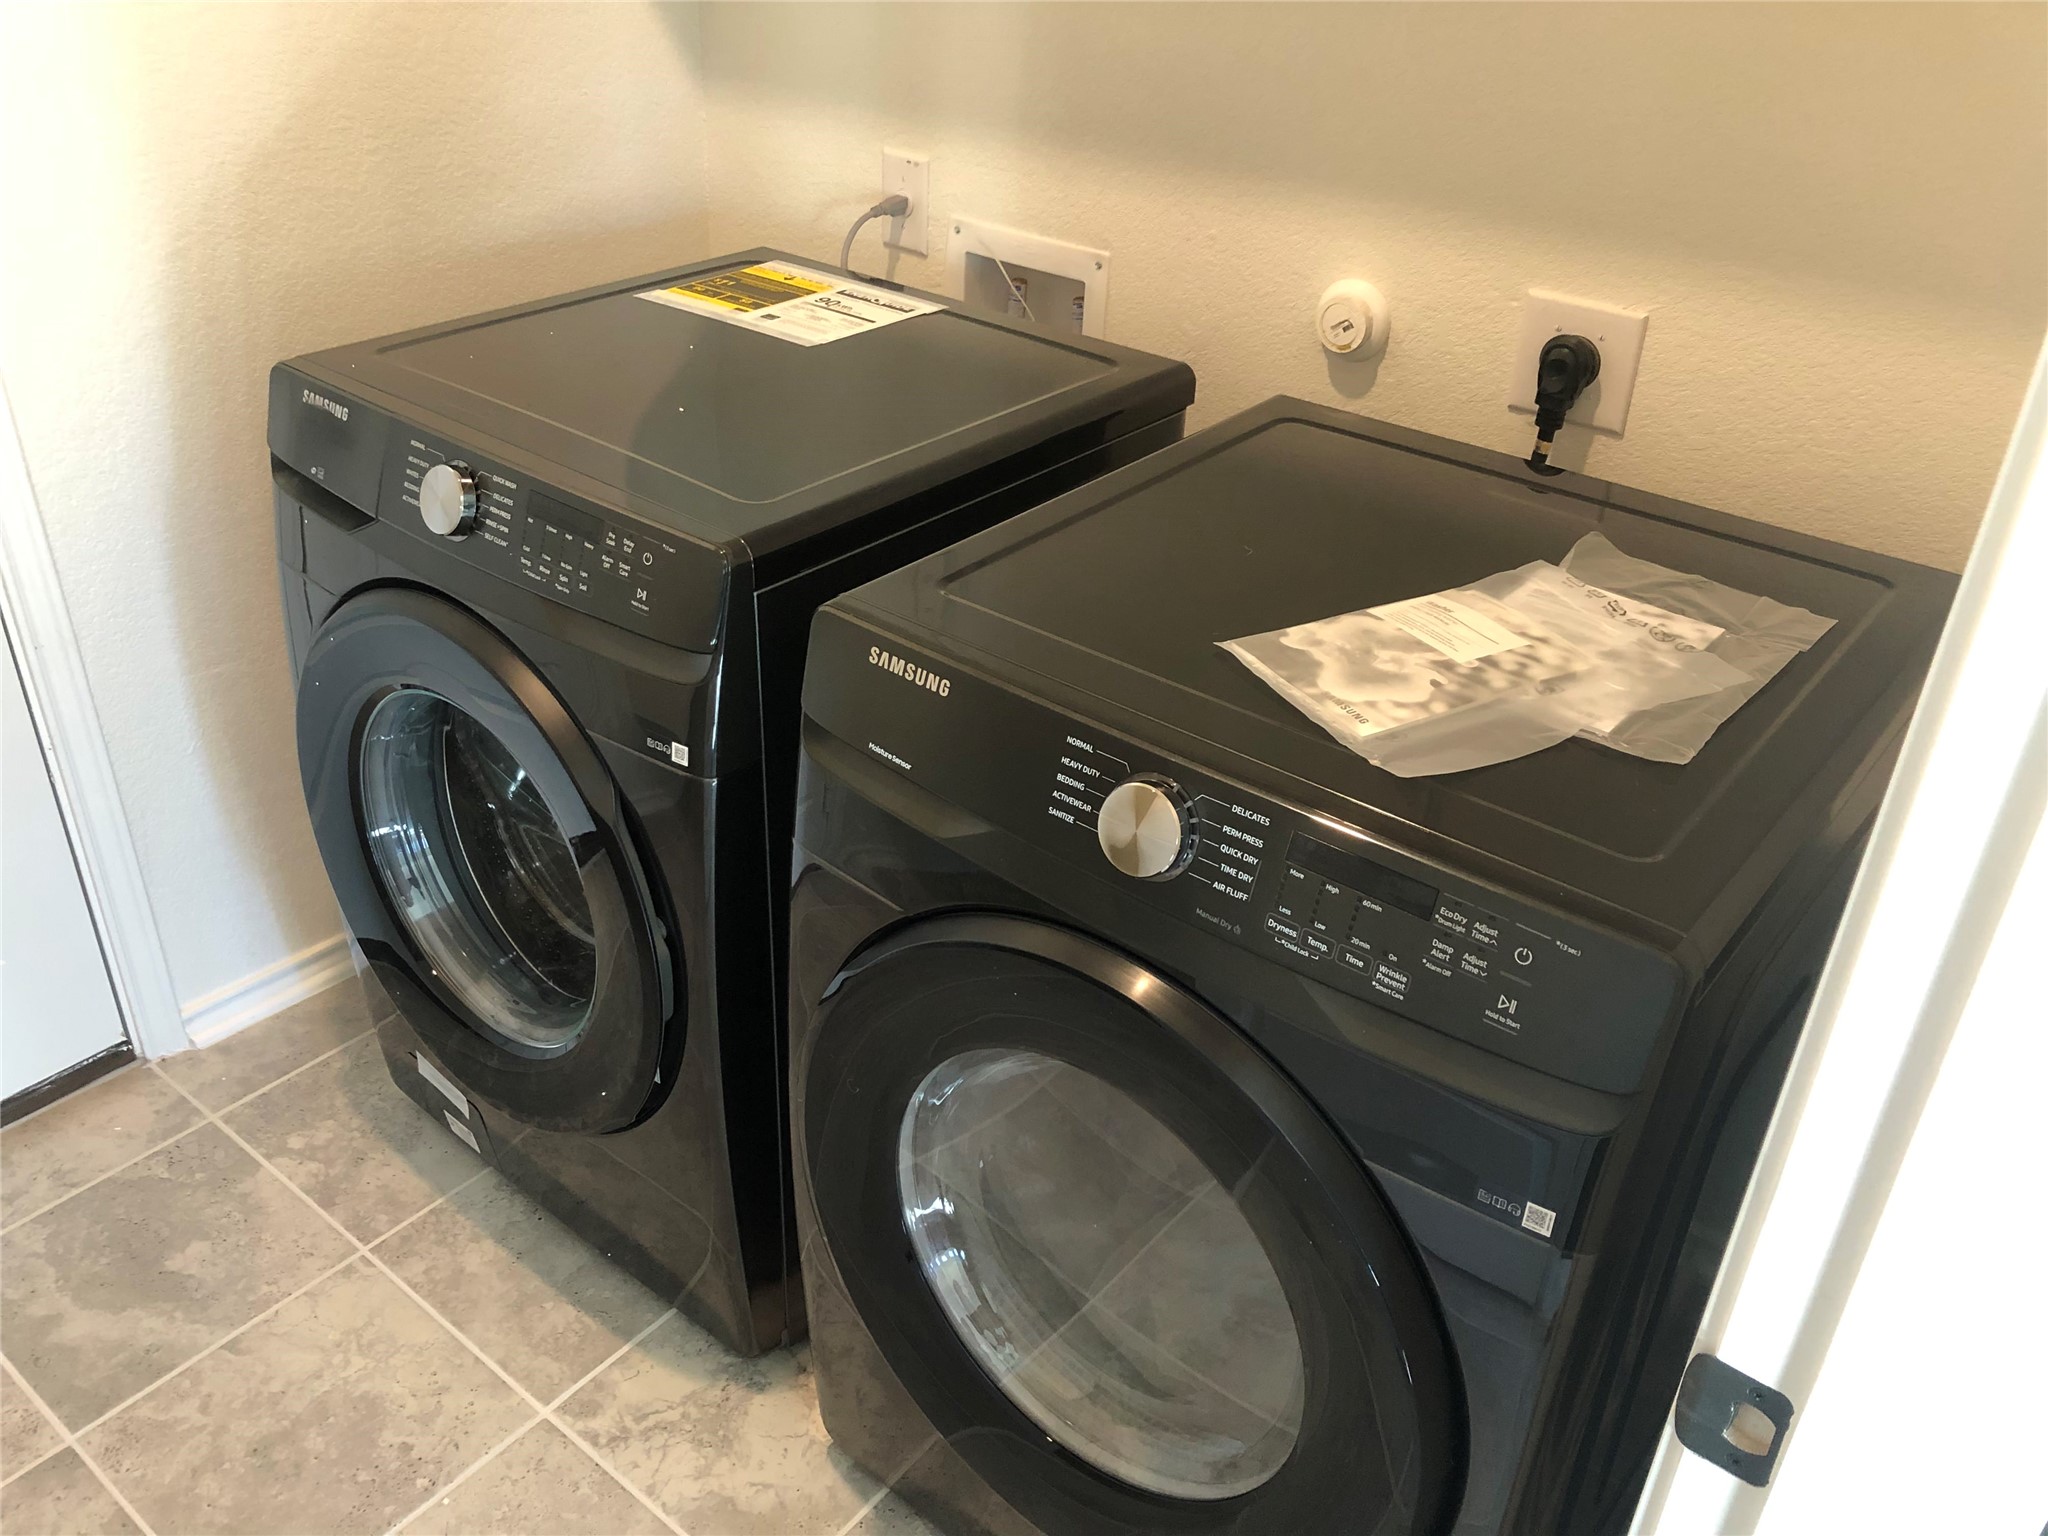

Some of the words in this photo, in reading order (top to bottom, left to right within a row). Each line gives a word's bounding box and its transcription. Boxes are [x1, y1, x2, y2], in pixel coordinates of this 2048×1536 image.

[814, 297, 842, 308] 90
[302, 389, 349, 421] SAMSUNG
[420, 460, 430, 468] DUTY
[505, 480, 517, 490] WASH
[493, 492, 514, 506] DELICATES
[484, 532, 494, 540] SELF
[606, 538, 616, 546] Soak
[623, 538, 635, 548] Delay
[624, 545, 632, 553] End
[602, 554, 614, 564] Alarm
[539, 565, 550, 574] Rinse
[619, 562, 631, 571] Smart
[619, 569, 628, 577] Care
[559, 574, 568, 582] Spin
[579, 583, 588, 591] Soil
[869, 646, 951, 697] SAMSUNG
[1321, 691, 1369, 724] MSUNG
[1066, 736, 1094, 753] NORMAL
[869, 742, 892, 759] Moisture
[892, 755, 912, 770] Sensor
[1061, 756, 1083, 770] HEAVY
[1083, 765, 1100, 778] DUTY
[1056, 773, 1085, 790] BEDDING
[1052, 790, 1092, 813] ACTIVEWEAR
[1048, 806, 1075, 824] SANITIZE
[1232, 804, 1270, 827] DELICATES
[1222, 825, 1242, 839] PERM
[1242, 833, 1264, 848] PRESS
[1220, 844, 1242, 860] QUICK
[1243, 853, 1259, 866] DRY
[1220, 863, 1237, 878] TIME
[1238, 872, 1254, 884] DRY
[1289, 868, 1305, 879] More
[1212, 881, 1225, 892] AIR
[1226, 886, 1249, 902] FLUFF
[1325, 884, 1339, 894] High
[1279, 905, 1291, 915] Less
[1362, 900, 1371, 908] 60
[1371, 903, 1382, 912] min
[1196, 907, 1220, 924] Manual
[1220, 918, 1232, 931] Dry
[1440, 906, 1453, 918] Eco
[1453, 912, 1468, 924] Dry
[1268, 918, 1297, 938] Dryness
[1314, 921, 1326, 931] Low
[1452, 923, 1466, 933] Light
[1474, 922, 1499, 937] Adjust
[1307, 935, 1328, 952] Temp.
[1351, 936, 1360, 945] 20
[1359, 940, 1370, 950] min
[1471, 930, 1490, 943] Time
[1297, 947, 1309, 957] Lock
[1432, 938, 1454, 954] Damp
[1345, 953, 1364, 968] Time
[1388, 953, 1398, 962] On
[1430, 948, 1450, 961] Alert
[1463, 952, 1488, 968] Adjust
[1379, 964, 1408, 983] Wrinkle
[1442, 969, 1452, 977] Off
[1461, 960, 1479, 974] Time
[1376, 972, 1406, 991] Prevent
[1392, 990, 1404, 1000] Care
[1485, 1009, 1499, 1020] Hold
[1506, 1018, 1521, 1029] Start
